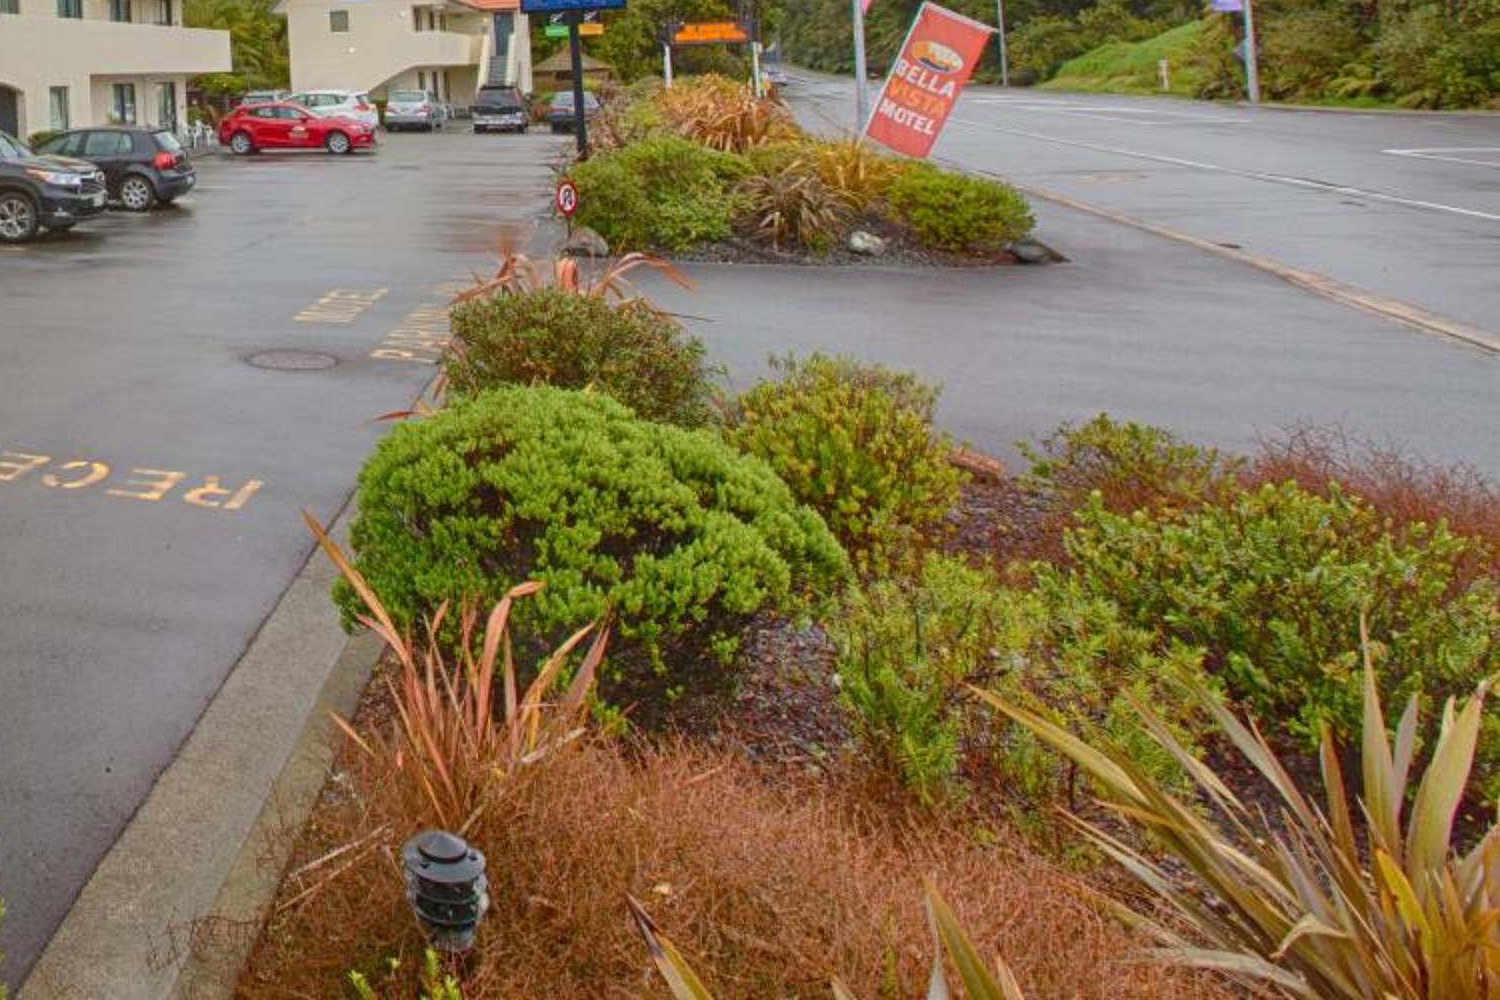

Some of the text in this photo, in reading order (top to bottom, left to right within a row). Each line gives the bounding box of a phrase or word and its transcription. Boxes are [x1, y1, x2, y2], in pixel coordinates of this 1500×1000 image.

[887, 78, 946, 118] VISTA
[895, 58, 956, 98] BELLA
[879, 99, 934, 135] MOTEL
